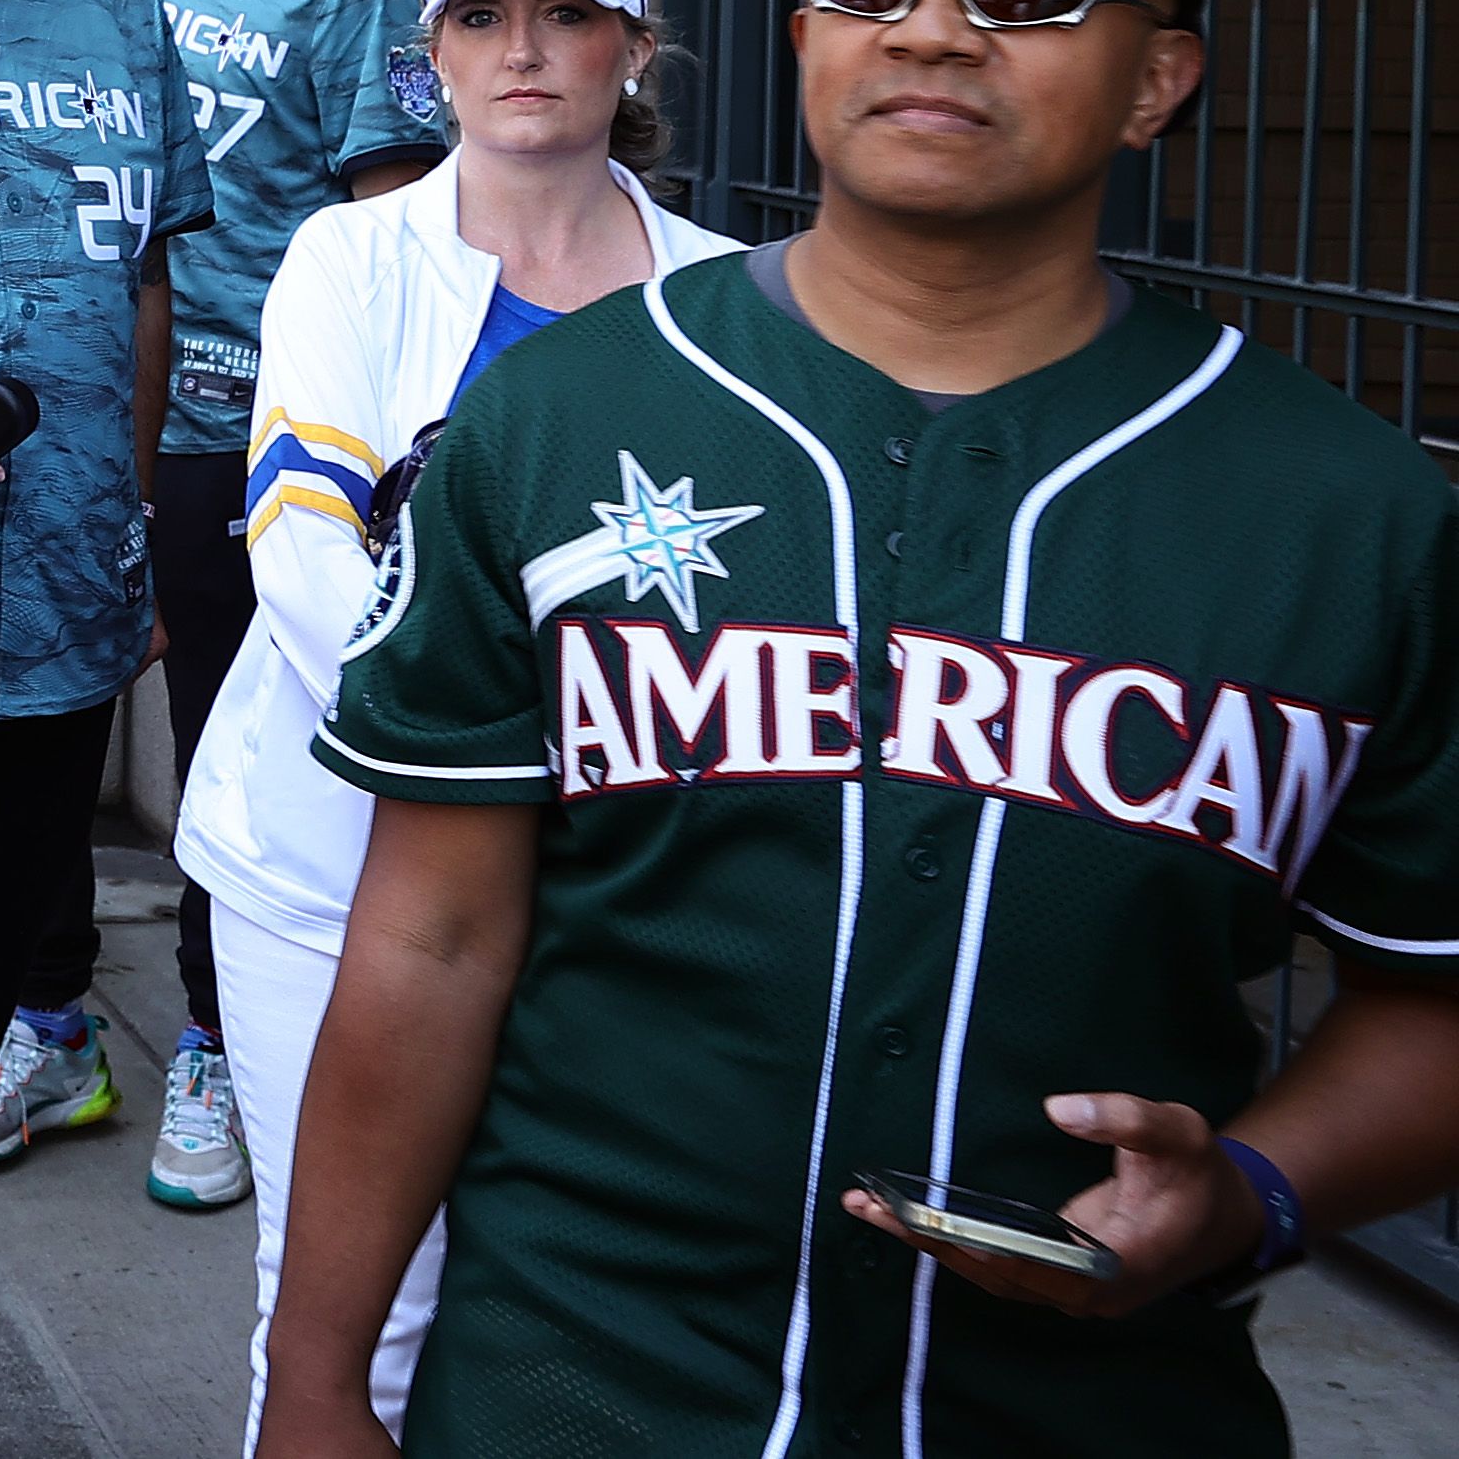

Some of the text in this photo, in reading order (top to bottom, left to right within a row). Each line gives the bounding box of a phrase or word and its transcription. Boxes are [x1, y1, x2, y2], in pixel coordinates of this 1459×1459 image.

[72, 165, 152, 261] 24
[183, 338, 259, 360] THE FUTURE
[224, 355, 258, 371] HERE
[557, 620, 1374, 900] AMERICAN
